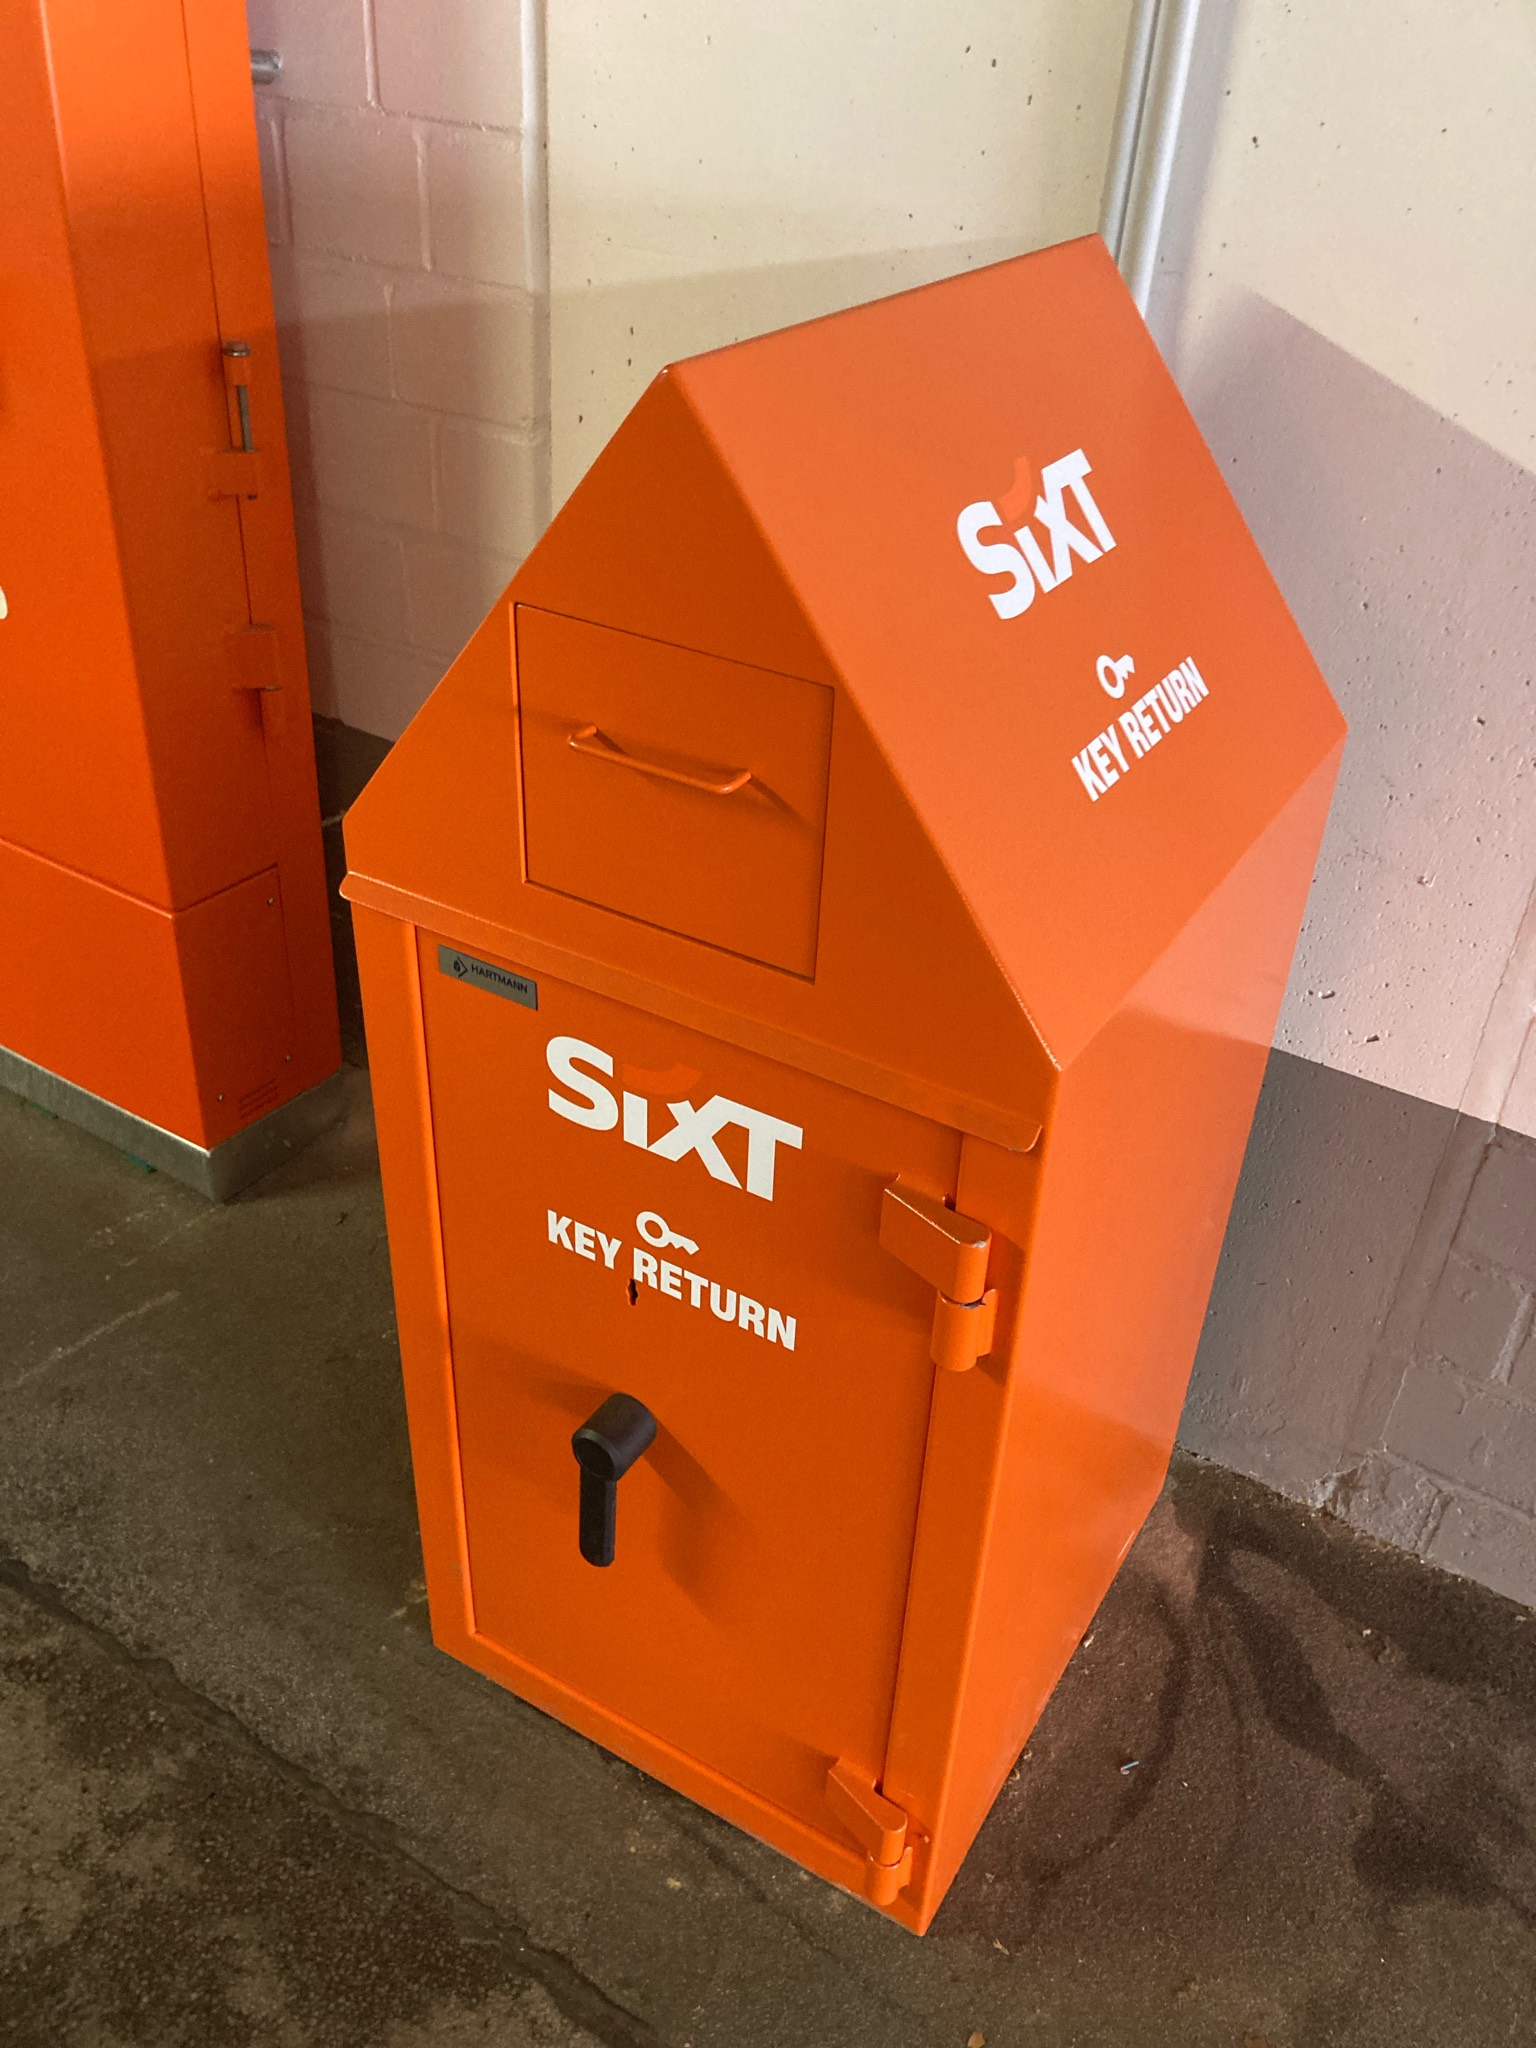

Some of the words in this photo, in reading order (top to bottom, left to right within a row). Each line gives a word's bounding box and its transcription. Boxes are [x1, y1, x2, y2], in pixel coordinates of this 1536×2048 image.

[1071, 725, 1130, 803] KEY
[1118, 656, 1210, 759] RETURN
[471, 963, 528, 994] HARTMANN
[547, 1209, 622, 1270] KEY
[632, 1247, 797, 1352] RETURN
